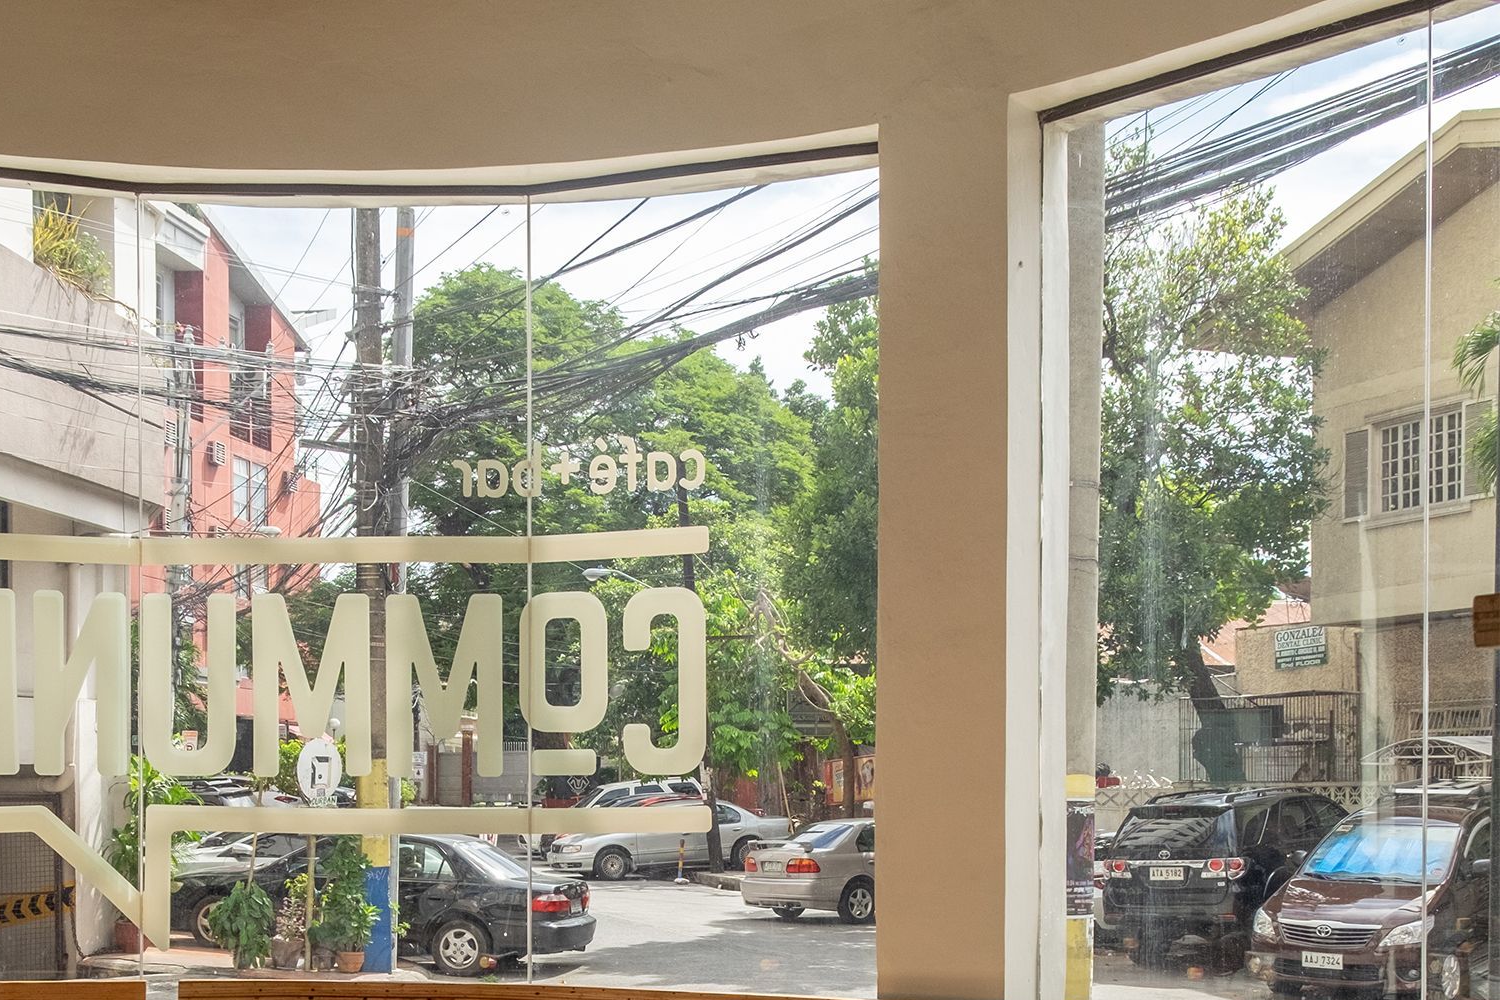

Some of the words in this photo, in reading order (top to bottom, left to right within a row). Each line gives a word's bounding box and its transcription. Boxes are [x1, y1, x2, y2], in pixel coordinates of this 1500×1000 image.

[1276, 626, 1324, 642] GONZALEZ
[1277, 639, 1300, 649] DENTAL
[1302, 636, 1323, 646] CLINIC
[1295, 659, 1321, 667] FLOOR
[1304, 954, 1318, 964] AAJ
[1321, 956, 1340, 965] 7324
